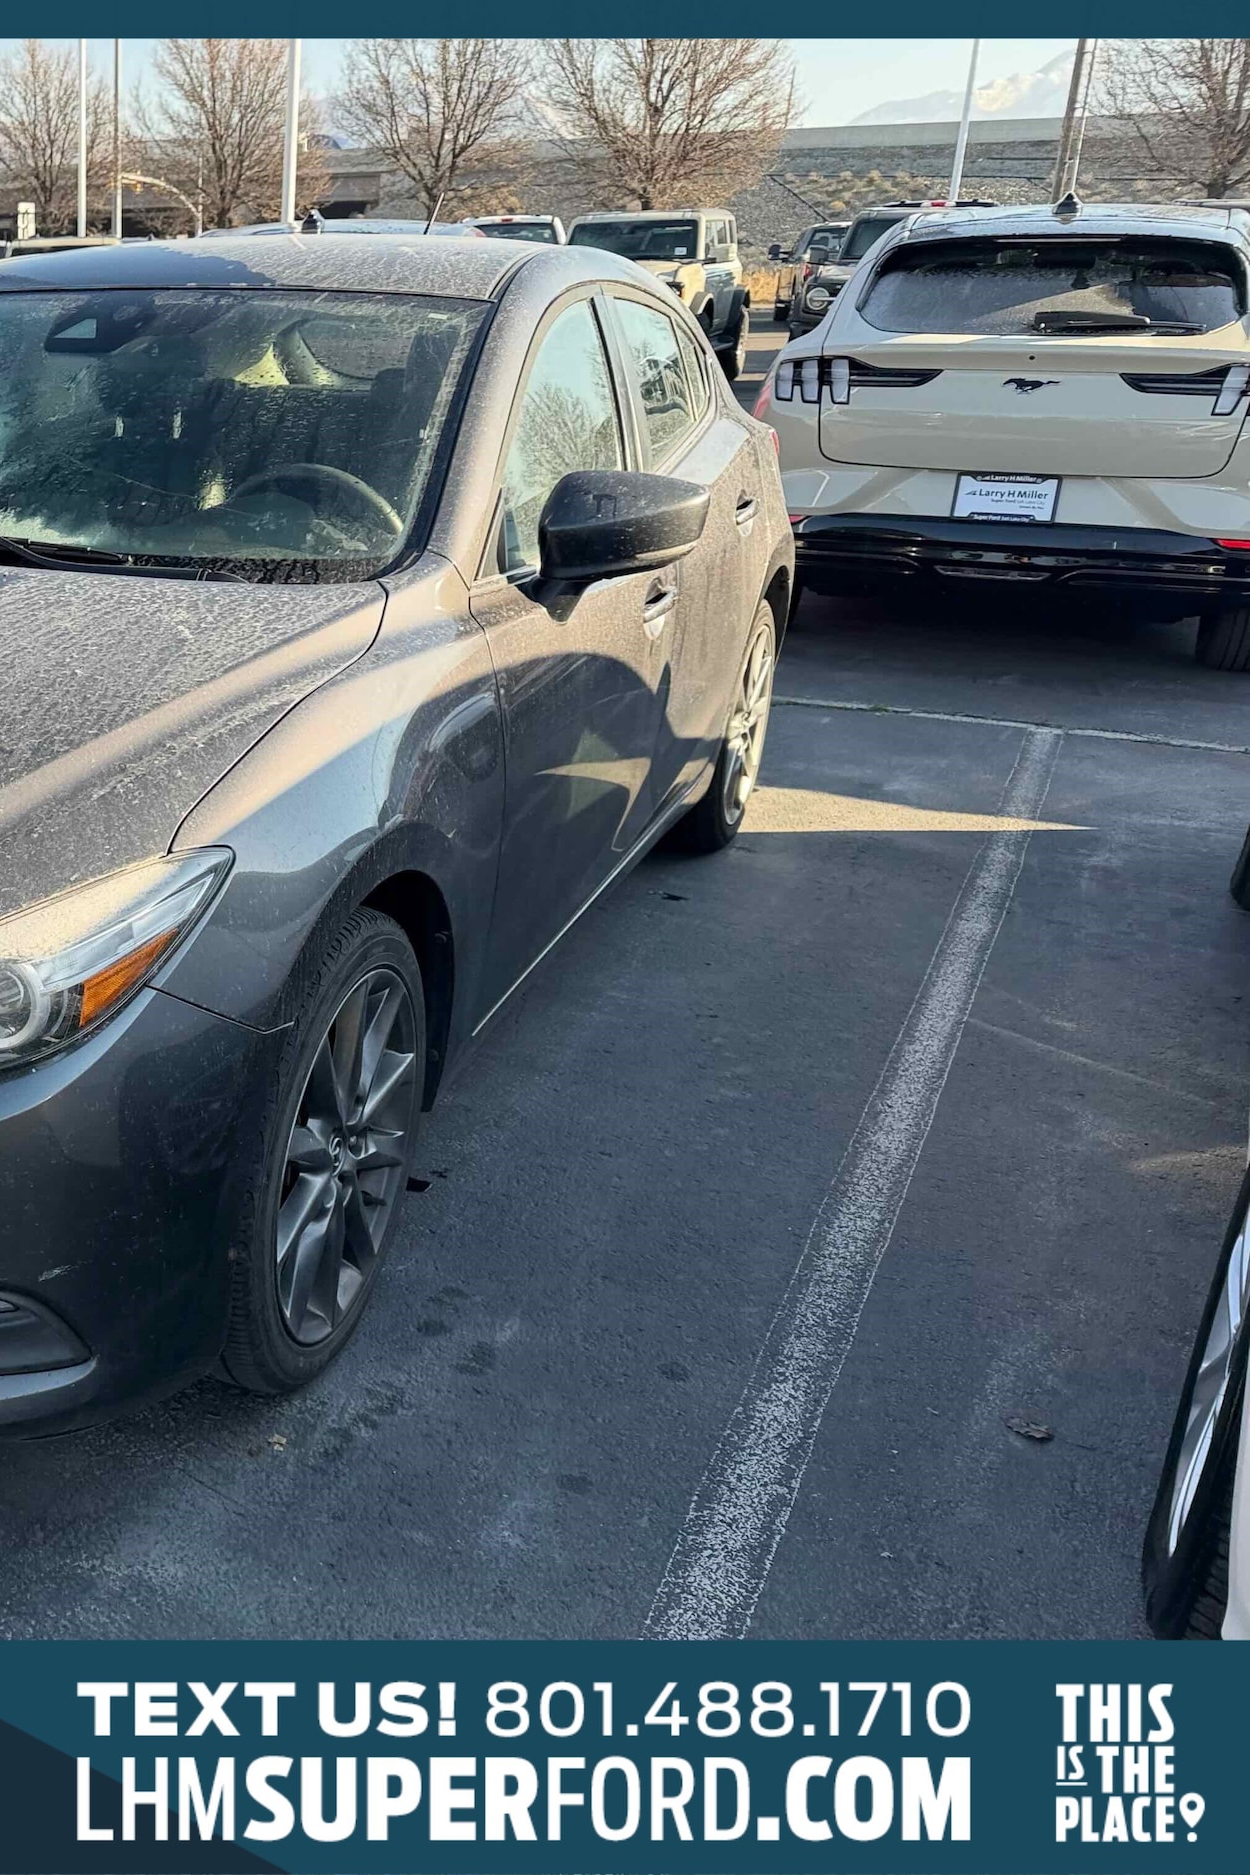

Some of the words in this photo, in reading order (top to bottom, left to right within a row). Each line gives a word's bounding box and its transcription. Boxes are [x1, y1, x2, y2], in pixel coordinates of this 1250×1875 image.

[991, 474, 1008, 482] Larry
[978, 488, 1006, 499] Larry
[1007, 489, 1016, 498] H
[1017, 490, 1049, 500] Miller
